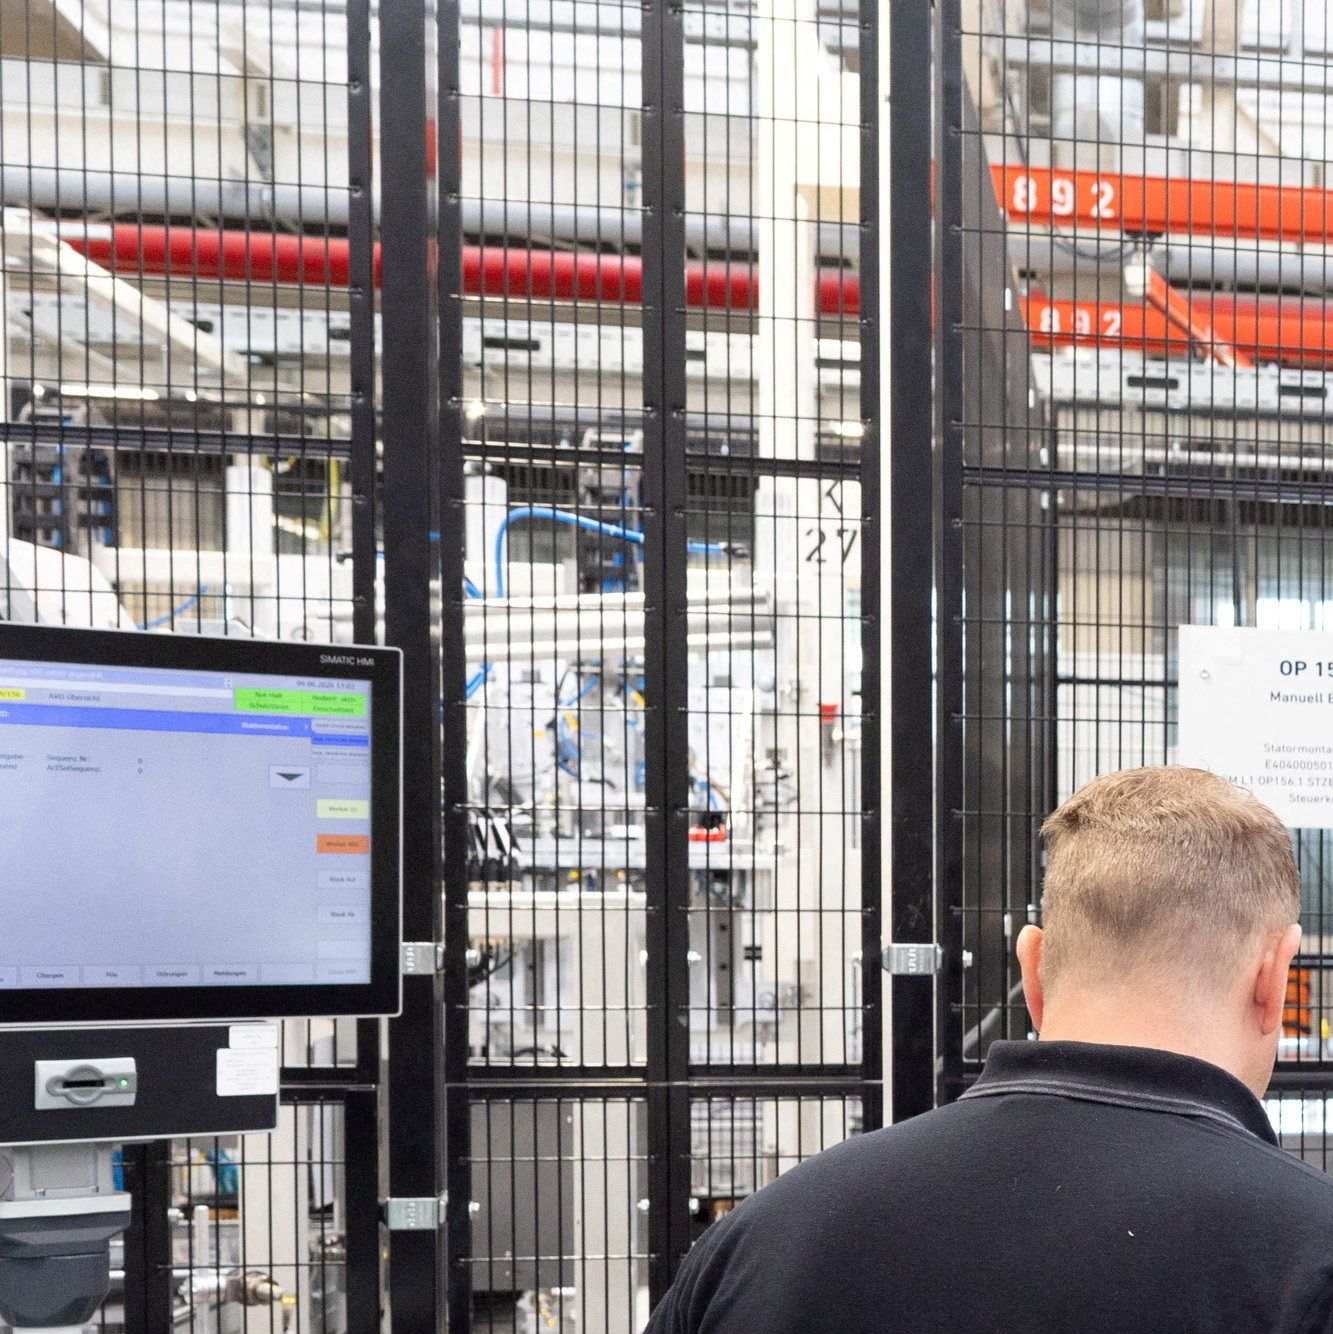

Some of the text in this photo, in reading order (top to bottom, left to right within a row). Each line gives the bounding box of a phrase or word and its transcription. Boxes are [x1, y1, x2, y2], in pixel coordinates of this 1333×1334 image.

[1013, 175, 1115, 219] 892
[319, 654, 375, 667] SIMATIC HMI
[1279, 660, 1307, 677] OP
[1270, 692, 1323, 704] Manuell
